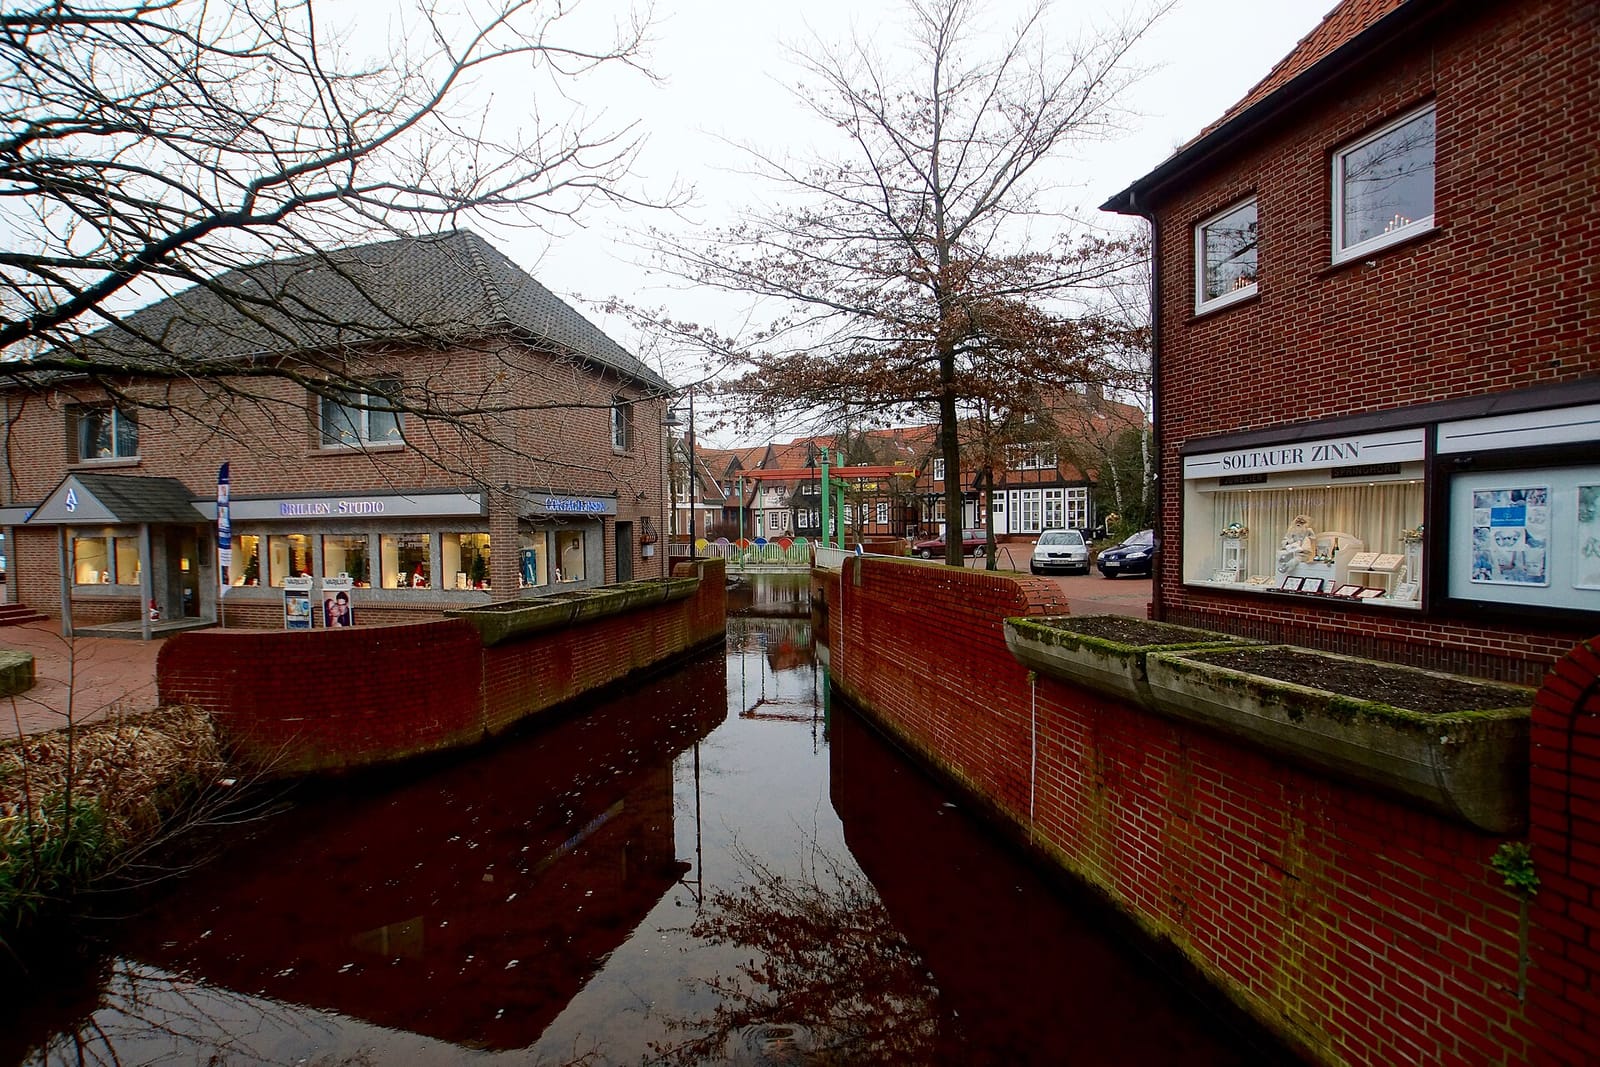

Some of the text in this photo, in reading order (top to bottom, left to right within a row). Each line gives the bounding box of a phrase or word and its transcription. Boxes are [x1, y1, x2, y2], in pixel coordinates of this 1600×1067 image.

[1222, 441, 1360, 470] SOLTAUER ZINN
[1334, 462, 1398, 477] SPRINGHORN
